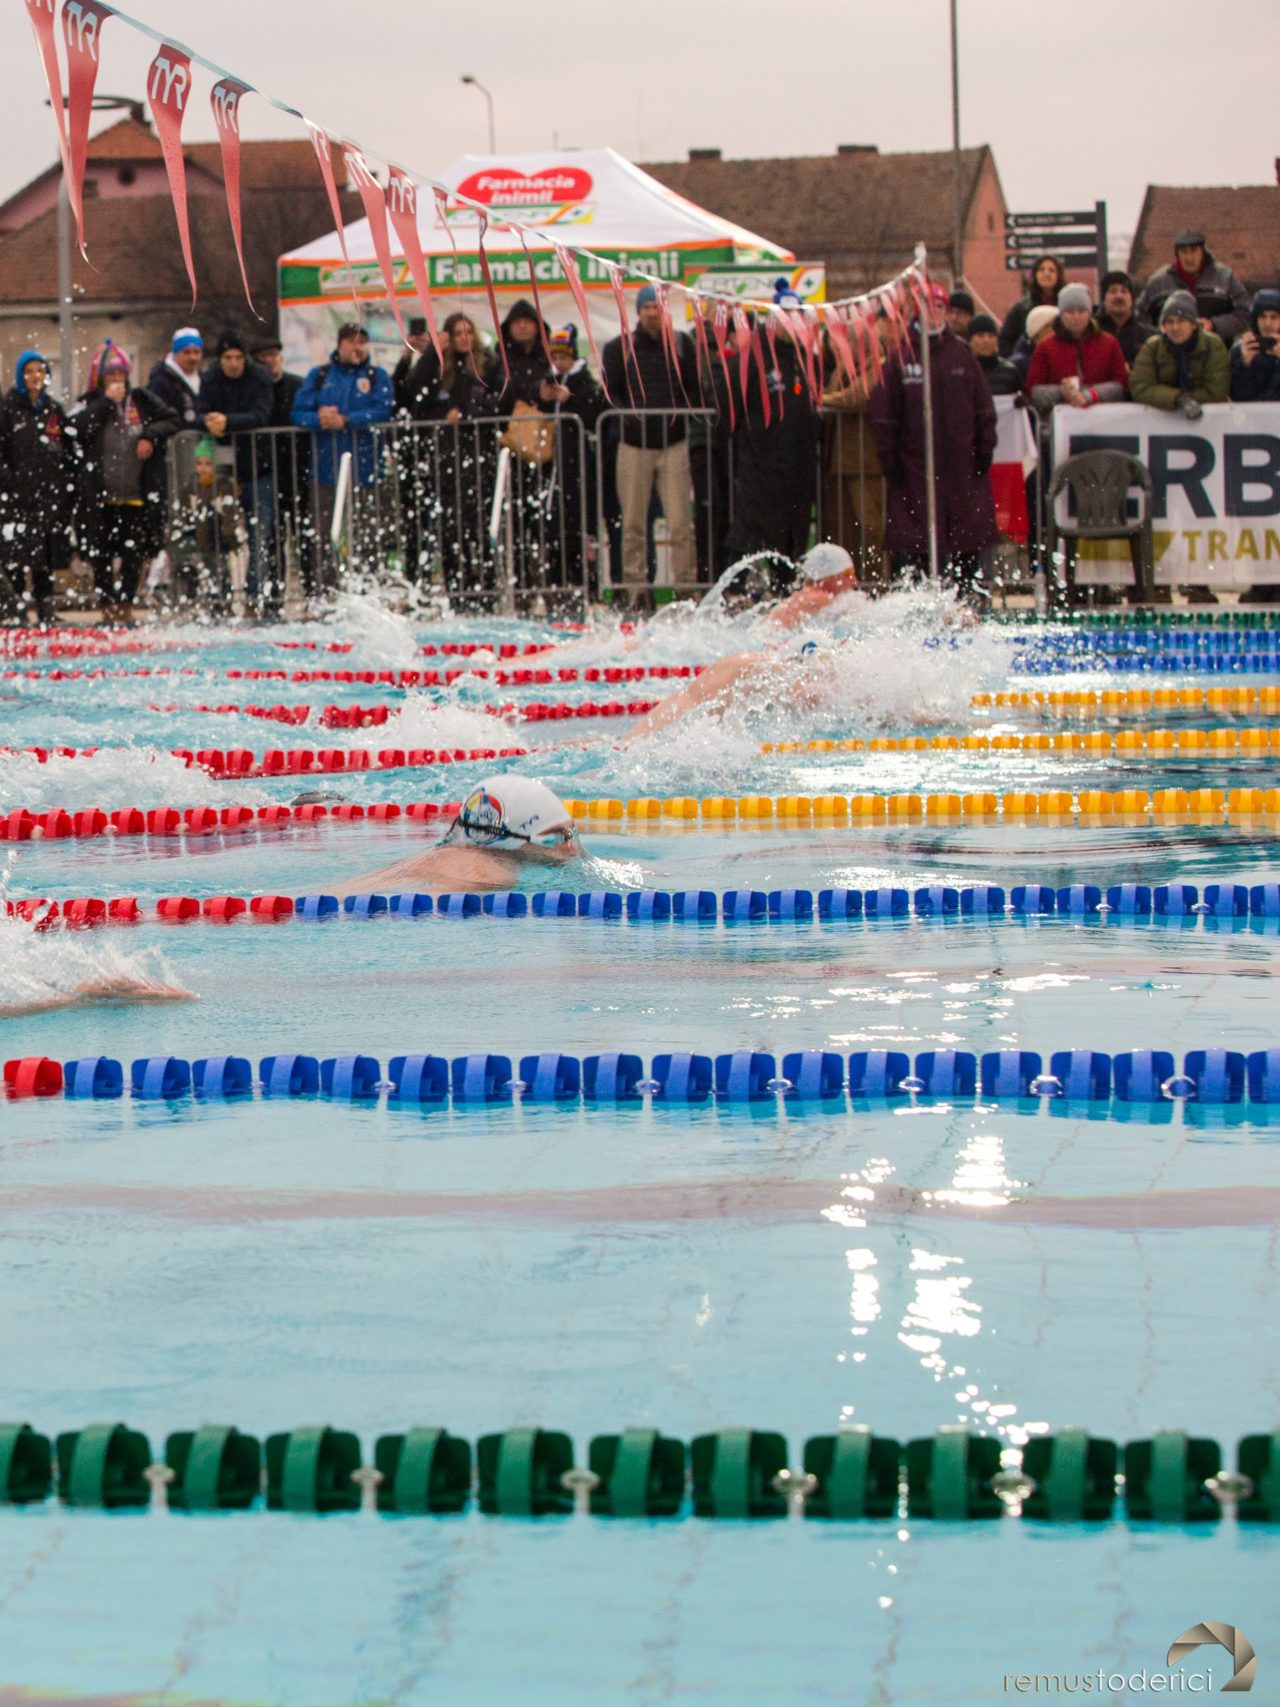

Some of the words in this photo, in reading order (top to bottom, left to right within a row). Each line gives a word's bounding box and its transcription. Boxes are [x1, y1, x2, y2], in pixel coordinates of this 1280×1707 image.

[67, 2, 99, 62] TYR
[151, 56, 187, 110] TYR
[213, 86, 238, 133] TYR
[390, 177, 415, 214] TYR
[477, 173, 576, 190] Farmacia
